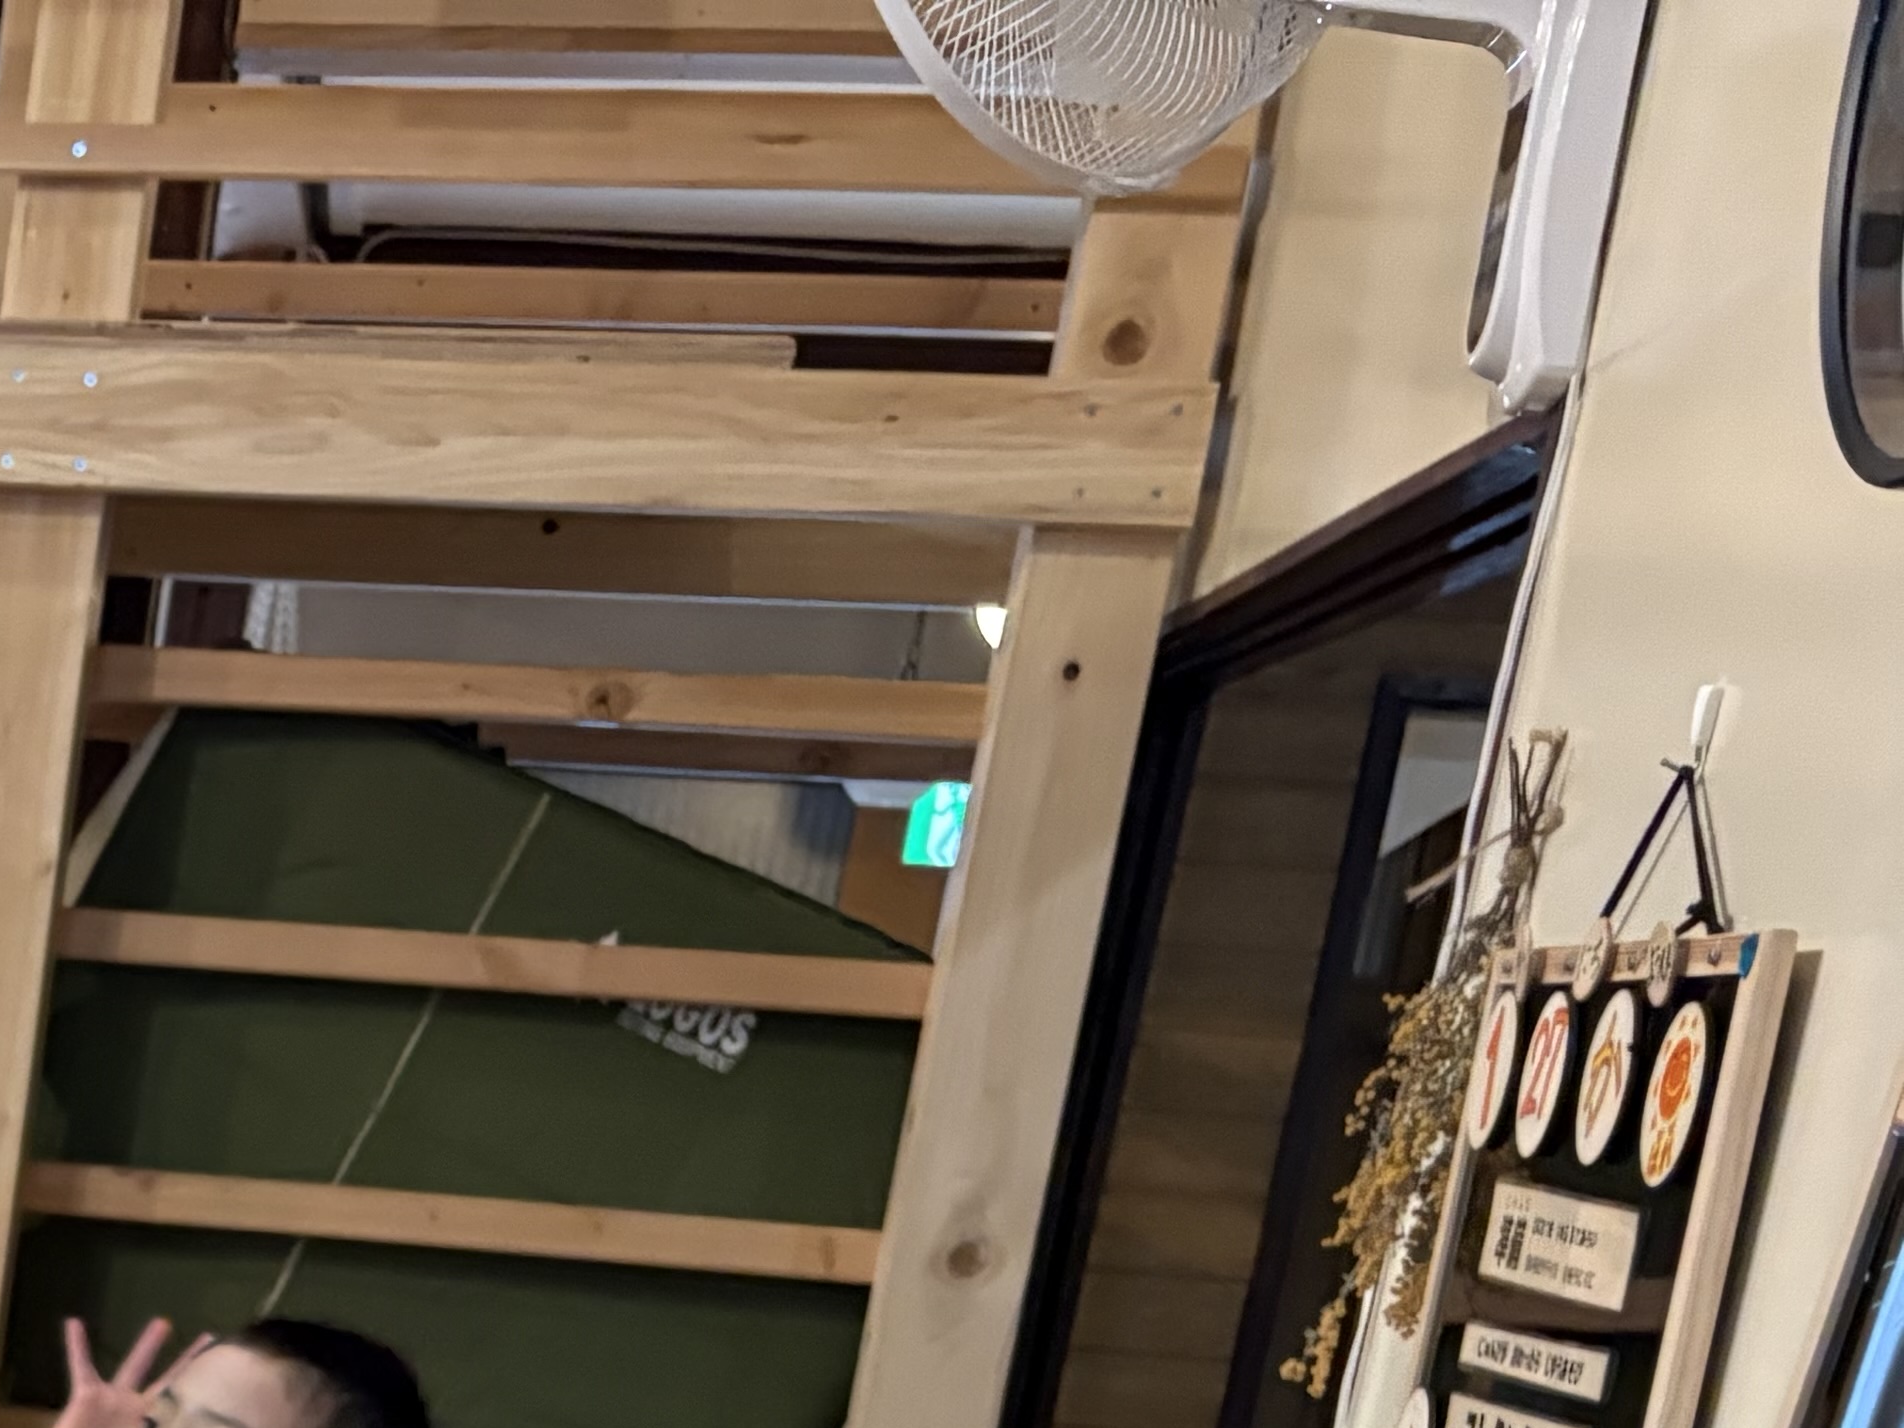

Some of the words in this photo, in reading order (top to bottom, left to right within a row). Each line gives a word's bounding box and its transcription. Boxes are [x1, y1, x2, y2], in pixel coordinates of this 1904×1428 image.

[626, 1001, 757, 1056] GOS
[1480, 1005, 1505, 1130] 1
[1520, 1007, 1569, 1120] 27
